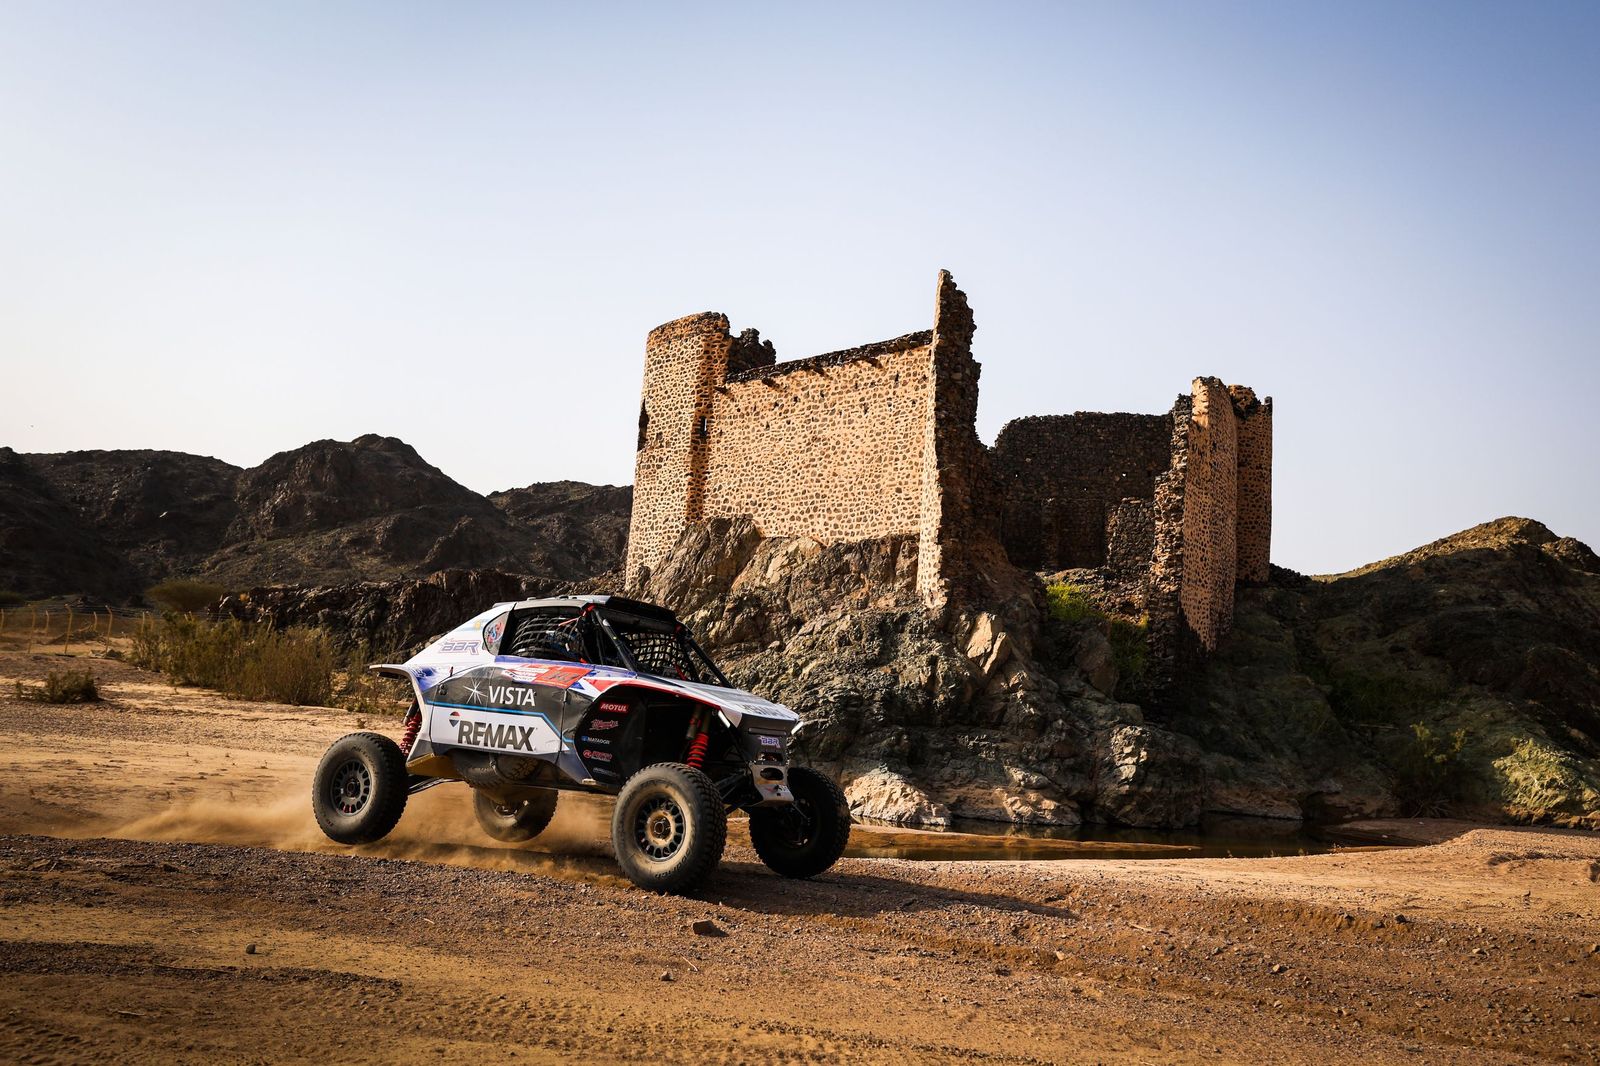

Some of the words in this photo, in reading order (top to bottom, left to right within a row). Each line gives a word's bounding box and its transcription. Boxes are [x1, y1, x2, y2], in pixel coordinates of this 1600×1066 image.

[489, 686, 535, 706] VISTA
[600, 703, 627, 711] MOTUL
[458, 720, 534, 752] REMAX
